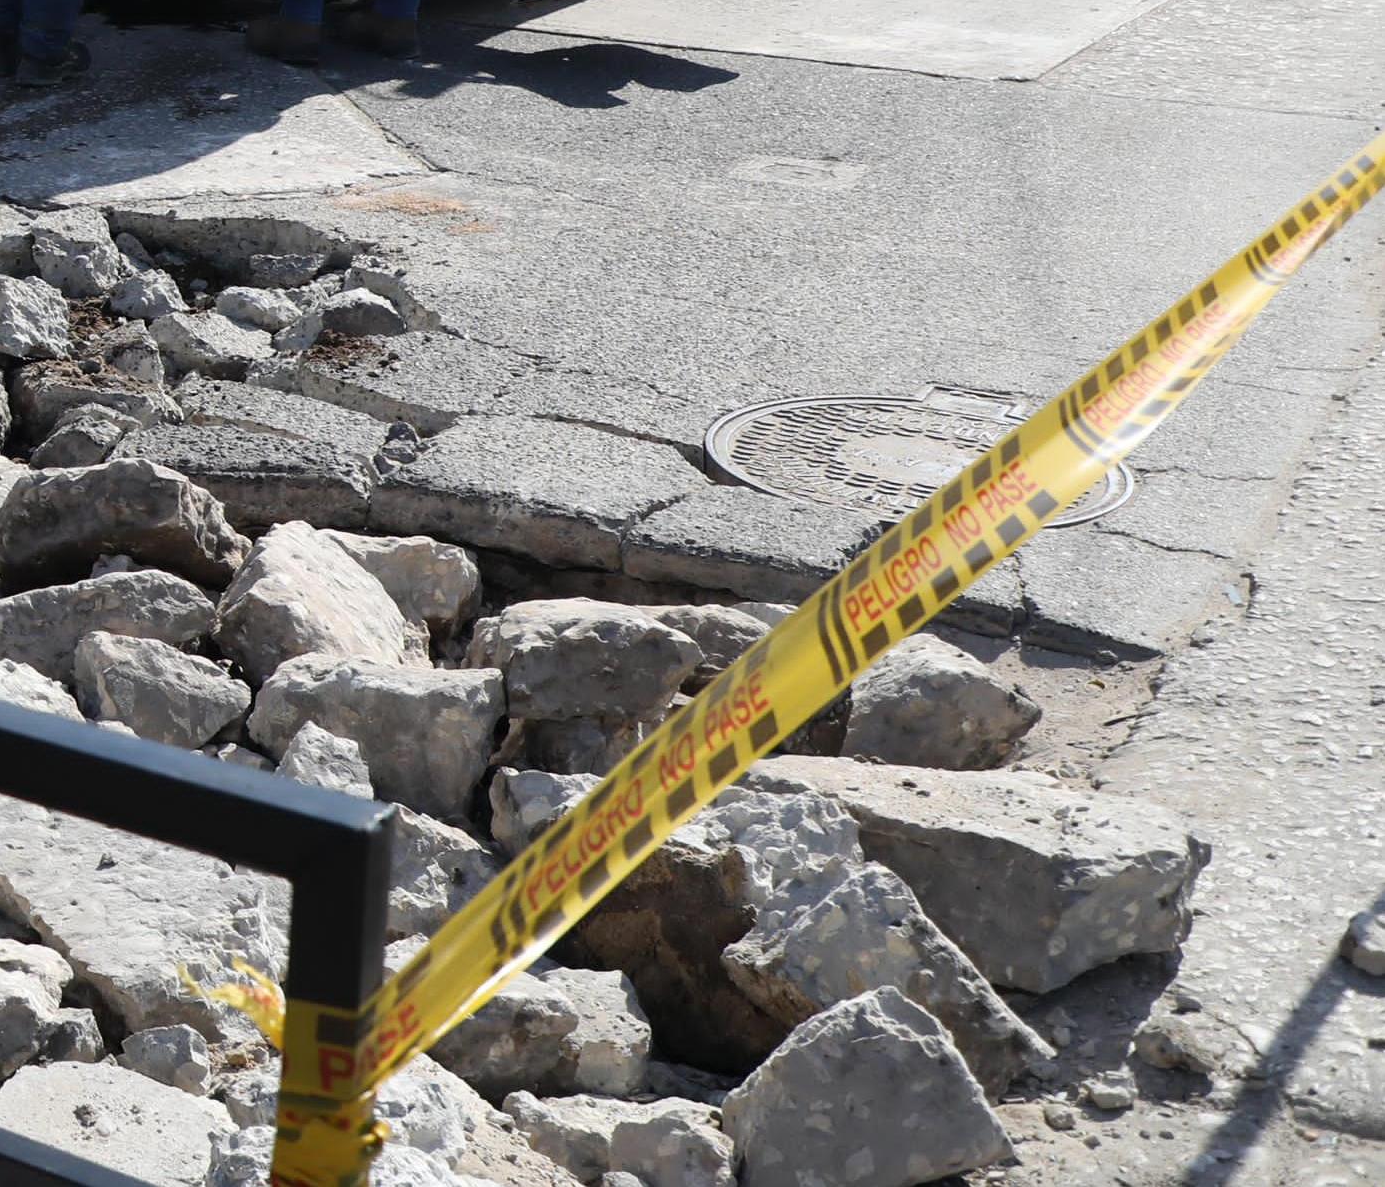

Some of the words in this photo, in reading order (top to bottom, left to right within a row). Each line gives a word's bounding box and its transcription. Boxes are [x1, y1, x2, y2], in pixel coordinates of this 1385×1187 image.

[1084, 363, 1165, 431] PELIGRO
[844, 536, 943, 631] PELIGRO
[943, 504, 982, 549] NO
[976, 461, 1038, 517] PASE
[525, 780, 644, 911] PELIGRO
[657, 731, 697, 791] NO
[703, 671, 770, 752] PASE
